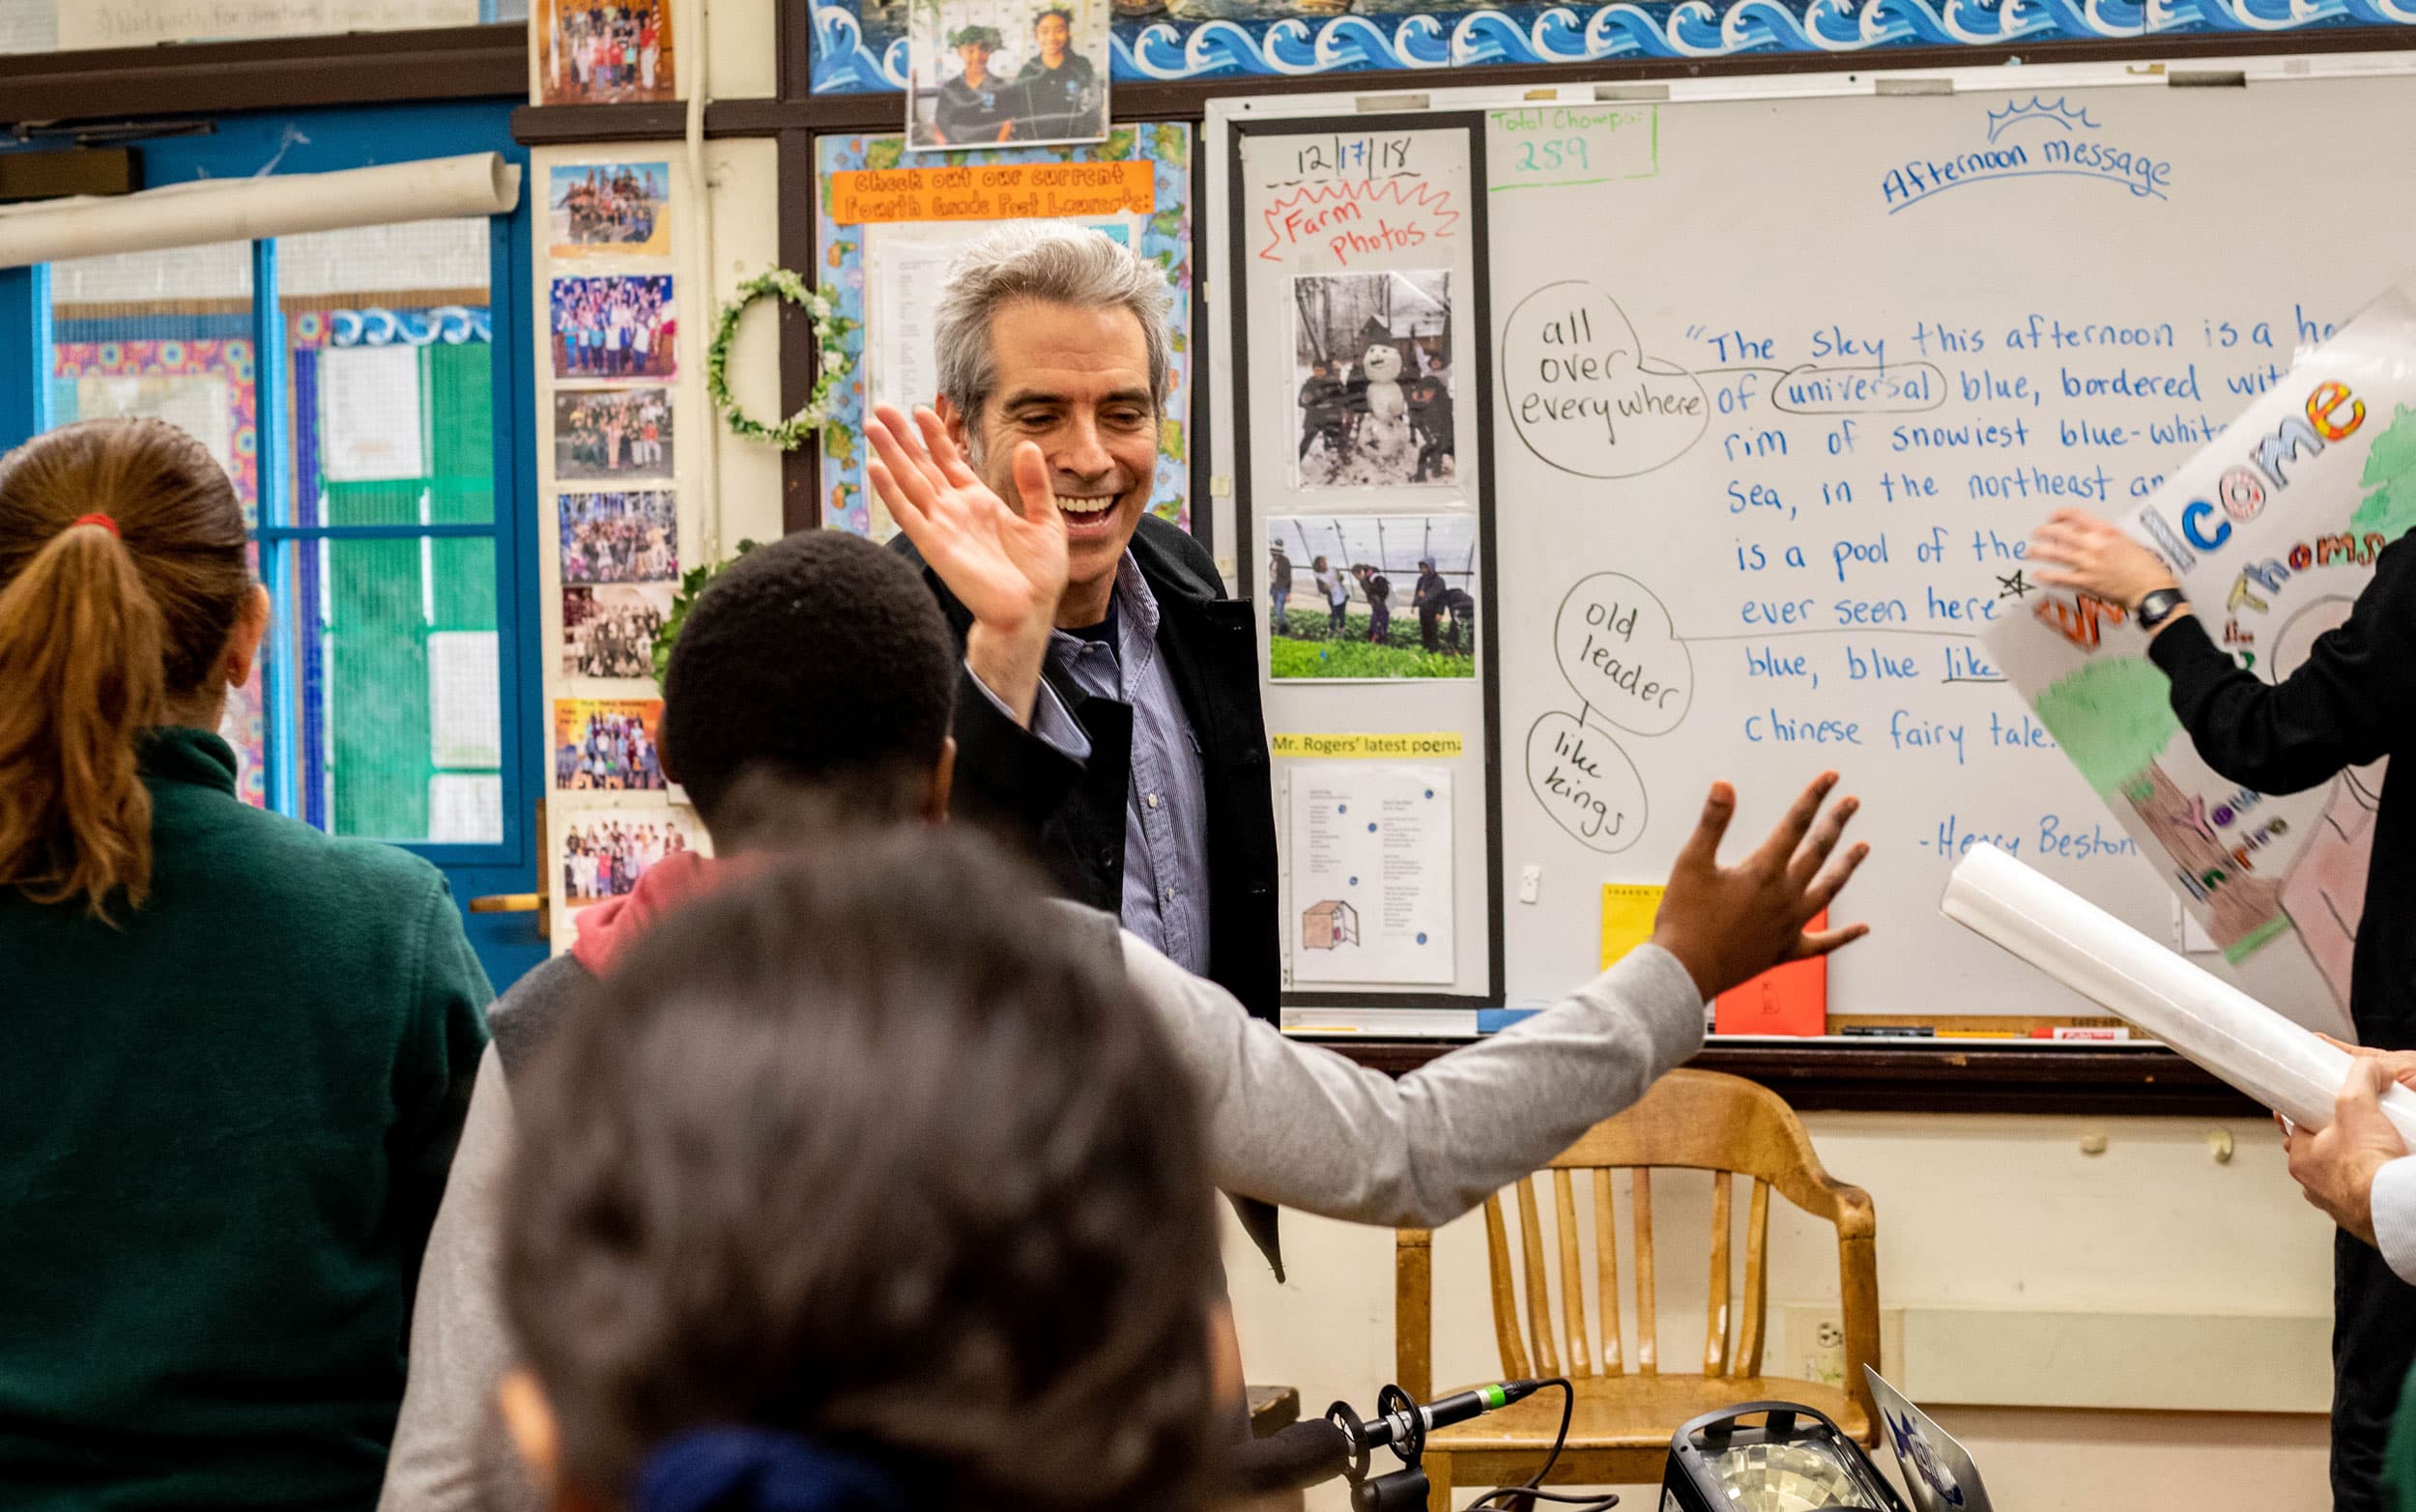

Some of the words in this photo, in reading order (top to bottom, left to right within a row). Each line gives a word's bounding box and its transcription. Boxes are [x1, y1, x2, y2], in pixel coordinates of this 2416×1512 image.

[1490, 107, 1542, 131] Total
[1298, 135, 1412, 181] 12/17/18
[1514, 135, 1589, 172] 289
[1883, 145, 2028, 203] Afternoon
[2043, 138, 2172, 197] message
[854, 170, 923, 192] Check
[931, 168, 972, 189] out
[982, 167, 1022, 187] our
[1030, 162, 1125, 186] current
[845, 195, 922, 219] Fourth
[1284, 200, 1362, 243] Farm
[1542, 307, 1592, 346] all
[1912, 321, 1984, 356] this
[2005, 314, 2174, 350] afternoon
[2203, 318, 2239, 349] is
[2252, 321, 2274, 349] a
[1540, 349, 1628, 384] over
[1717, 372, 1758, 414] of
[1789, 370, 1930, 406] universal
[1960, 369, 2039, 407] blue,
[2061, 363, 2202, 402] bordered
[1521, 382, 1701, 446] everywhere
[1723, 426, 1788, 462] rim
[1827, 418, 1856, 456] of
[1891, 416, 2029, 452] snowiest
[1823, 479, 1854, 506] in
[1880, 471, 1940, 503] the
[1968, 464, 2114, 502] northeast
[2033, 380, 2366, 655] Wlcome
[1735, 537, 1767, 572] is
[1785, 545, 1807, 569] a
[1832, 532, 1889, 584] pool
[1917, 526, 1949, 563] of
[1971, 529, 2028, 561] the
[1585, 601, 1638, 642] old
[1740, 598, 1816, 625] ever
[1833, 597, 1909, 626] seen
[1927, 585, 2001, 621] here
[1580, 634, 1680, 709] leader
[1745, 645, 1819, 691] blue,
[1846, 645, 1921, 681] blue
[1944, 645, 2001, 681] like
[1273, 736, 1299, 752] Mr.
[1304, 736, 1361, 755] Rogers'
[1364, 736, 1408, 753] latest
[1412, 738, 1462, 755] poem:
[1553, 730, 1603, 780] like
[1889, 708, 1965, 766] fairy
[1990, 710, 2056, 749] tale.
[1543, 765, 1625, 838] kings
[2039, 813, 2138, 861] Beston
